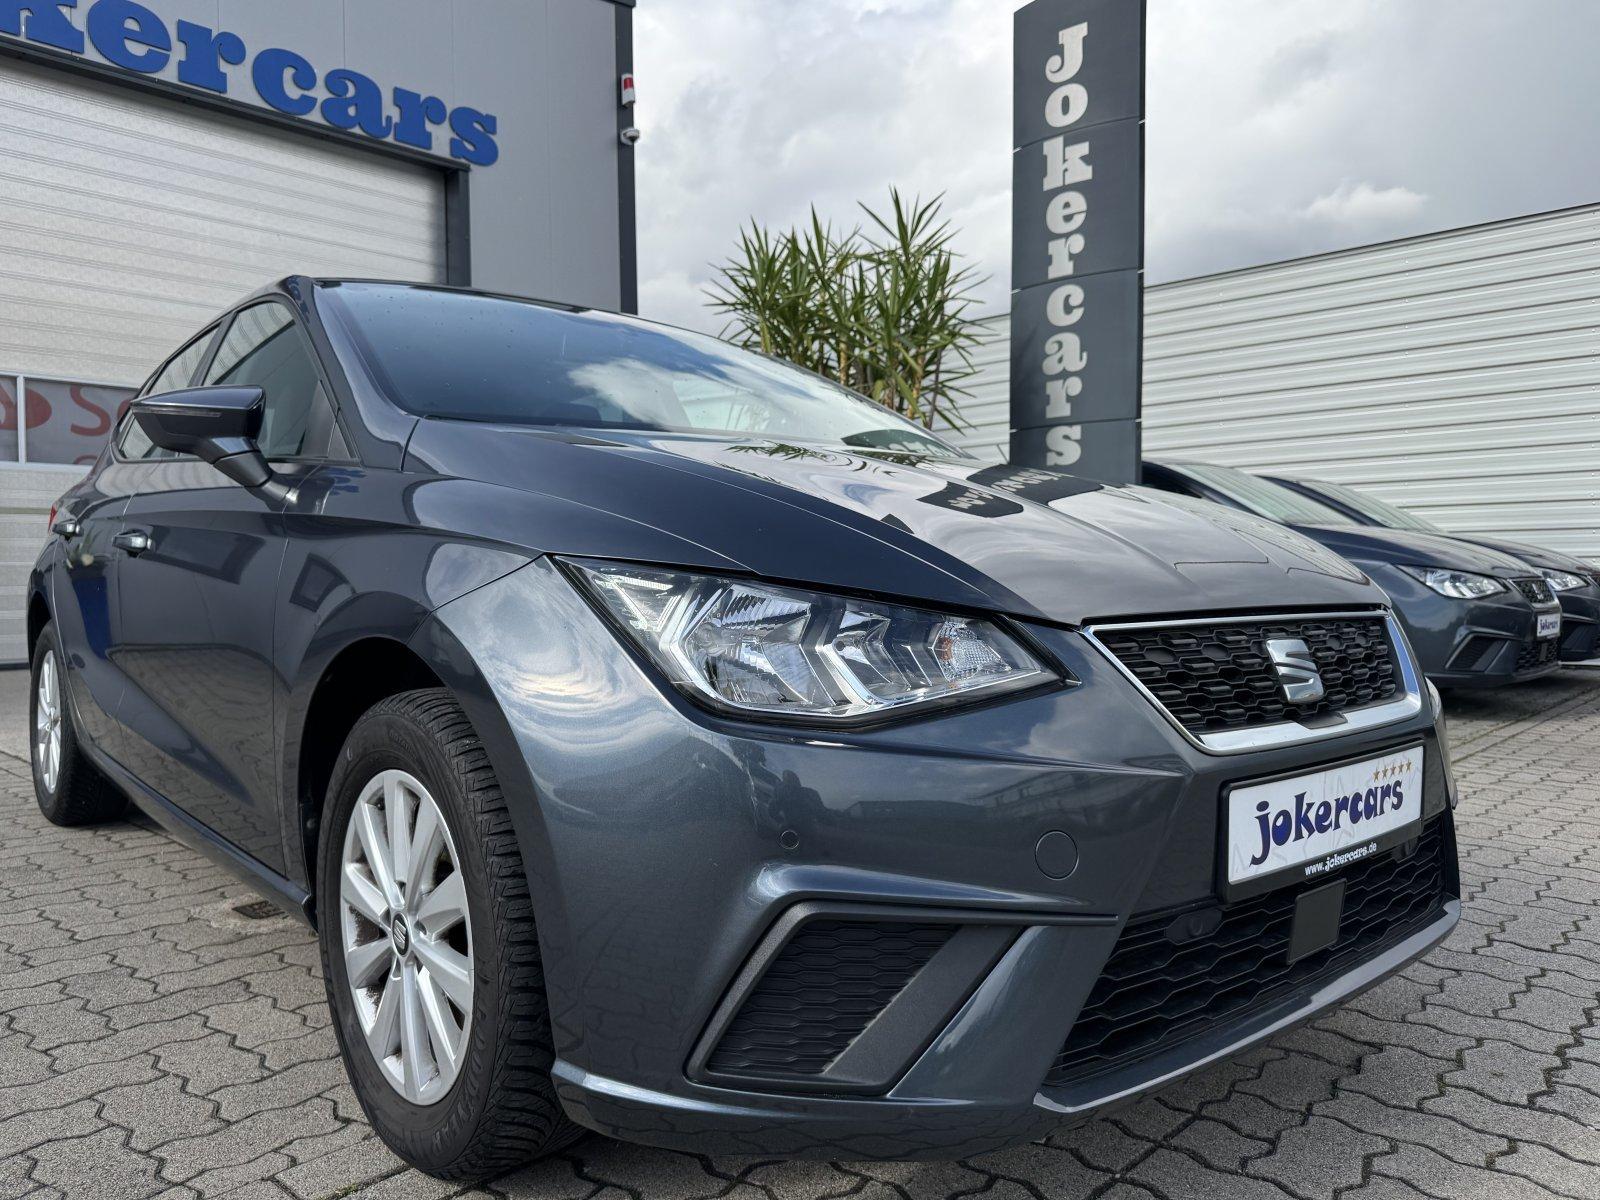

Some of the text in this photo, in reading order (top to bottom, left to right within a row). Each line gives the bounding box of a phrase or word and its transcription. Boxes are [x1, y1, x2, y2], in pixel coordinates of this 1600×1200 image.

[1042, 22, 1093, 467] Jokercars
[1249, 779, 1403, 867] jokercars
[1304, 842, 1377, 876] www.jokercars.de
